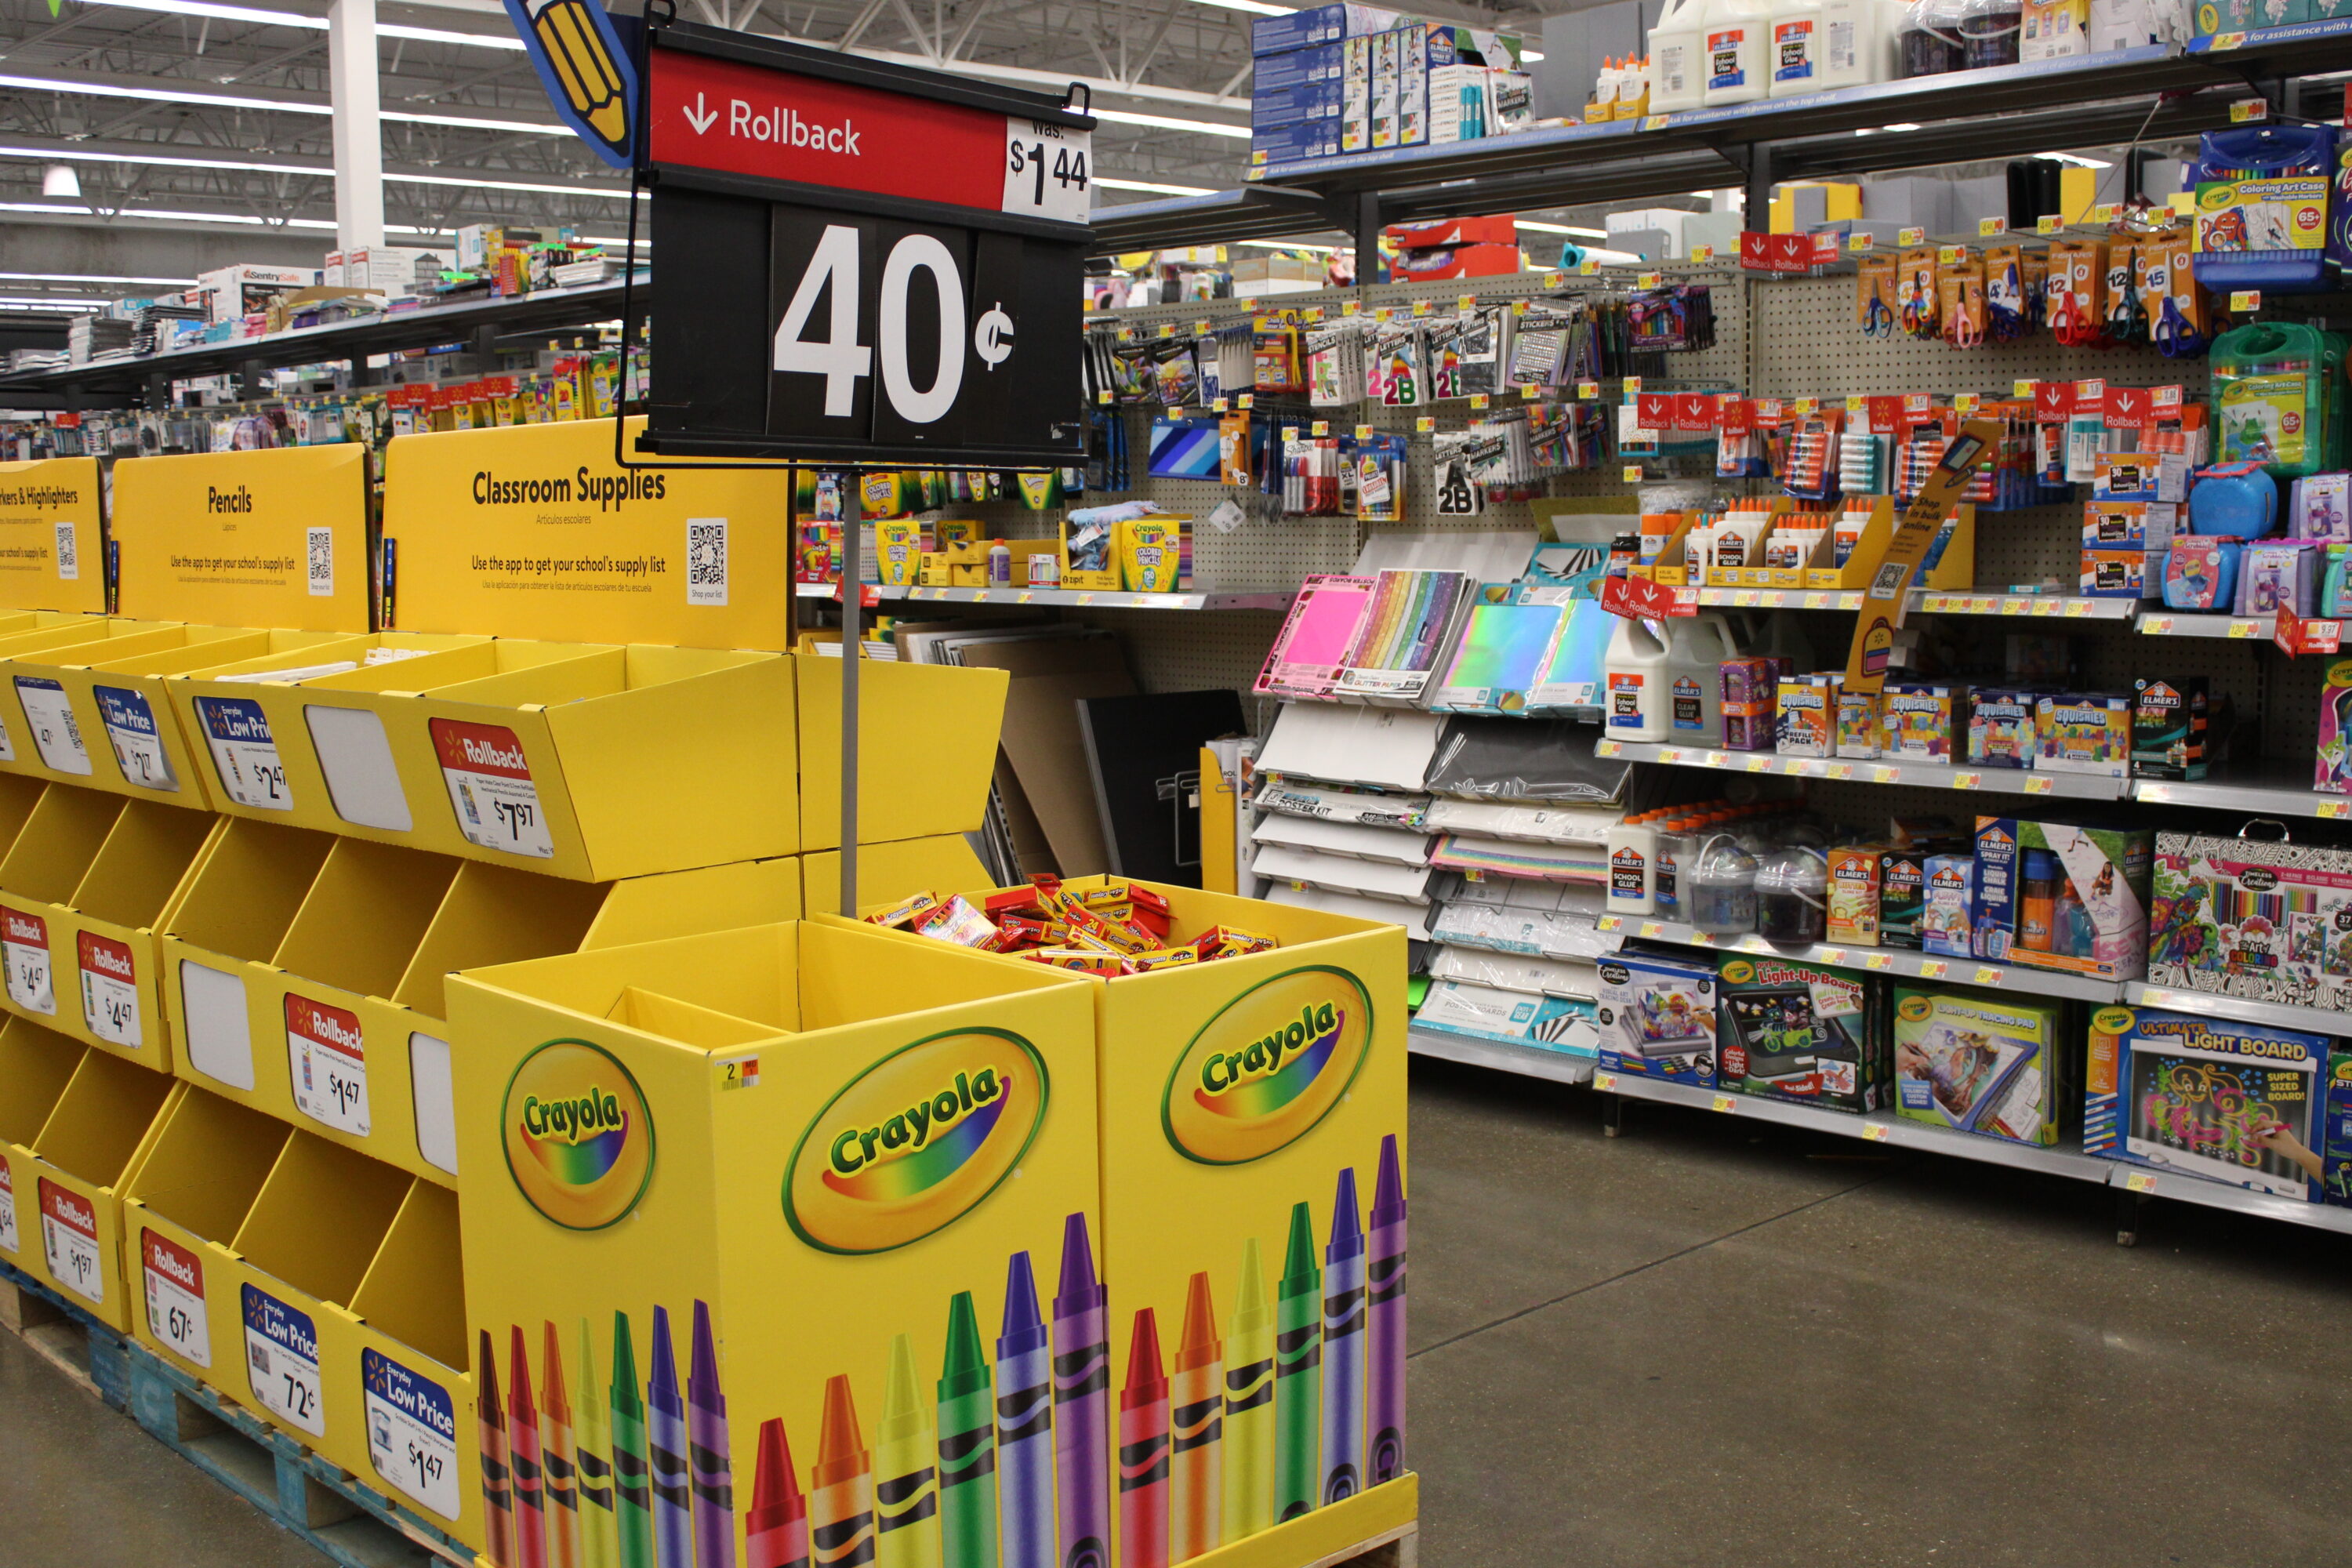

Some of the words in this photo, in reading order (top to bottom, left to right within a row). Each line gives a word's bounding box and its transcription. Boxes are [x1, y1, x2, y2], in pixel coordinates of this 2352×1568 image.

[2251, 33, 2265, 42] for
[2267, 27, 2321, 40] assistance
[2323, 21, 2348, 33] with
[1498, 94, 1526, 110] MARKERS
[1668, 115, 1681, 125] Ask
[1682, 114, 1693, 124] for
[1694, 107, 1736, 122] assistance
[1773, 102, 1785, 111] on
[1786, 99, 1798, 109] the
[1800, 96, 1814, 108] top
[730, 99, 860, 156] Rollback
[2239, 183, 2281, 196] Coloring
[2282, 183, 2299, 192] Art
[2299, 182, 2326, 191] Case
[2297, 212, 2321, 223] 65+
[2148, 238, 2189, 252] FISKARS
[2051, 251, 2093, 260] FISKARS
[1742, 256, 1772, 270] Rollback
[1774, 258, 1806, 271] Rollback
[250, 270, 299, 283] SentrySafe
[1519, 318, 1555, 329] STICKERS
[1308, 337, 1337, 354] STENCILS
[1380, 335, 1406, 350] LETTERS
[2038, 410, 2067, 421] Rollback
[2106, 415, 2143, 427] Rollback
[2282, 416, 2301, 426] 65+
[1639, 417, 1669, 430] Rollback
[1680, 418, 1708, 430] Rollback
[1286, 443, 1314, 456] Sharpie
[1470, 443, 1501, 459] MARKERS
[473, 472, 571, 505] Classroom
[577, 466, 666, 512] Supplies
[19, 487, 25, 505] &
[27, 485, 78, 510] Highlighters
[208, 485, 252, 514] Pencils
[1918, 496, 1940, 510] Shop
[1919, 510, 1942, 521] bulk
[886, 524, 907, 533] Crayola
[1135, 524, 1163, 533] Crayola
[1903, 521, 1933, 532] online
[1719, 538, 1744, 546] ELMER'S
[171, 555, 181, 568] Use
[183, 556, 192, 568] the
[193, 557, 203, 572] app
[205, 557, 211, 568] to
[212, 557, 222, 572] get
[223, 559, 236, 572] your
[238, 556, 262, 570] school's
[263, 558, 283, 573] supply
[285, 557, 295, 570] list
[472, 555, 487, 570] Use
[489, 556, 503, 571] the
[506, 559, 522, 575] app
[524, 557, 534, 571] to
[536, 557, 551, 575] get
[554, 560, 574, 575] your
[575, 556, 613, 572] school's
[615, 557, 648, 577] supply
[650, 556, 666, 573] list
[1069, 575, 1084, 585] zipit
[691, 590, 703, 600] Shop
[705, 591, 715, 600] your
[1628, 600, 1663, 619] Rollback
[2307, 641, 2336, 649] Rollback
[1674, 687, 1701, 696] ELMER'S
[1883, 685, 1901, 694] NEW
[1780, 695, 1824, 711] SQUISHIES
[1891, 697, 1940, 714] SQUISHIES
[2143, 695, 2178, 706] ELMER'S
[110, 706, 125, 726] Low
[126, 708, 151, 731] Price
[221, 706, 242, 717] Everyday
[2054, 709, 2107, 728] SQUISHIES
[224, 715, 249, 737] Low
[248, 716, 271, 739] Pri
[463, 738, 528, 771] Rollback
[1316, 805, 1334, 816] KIT
[1980, 840, 2013, 851] ELMER'S
[1613, 857, 1644, 866] ELMER'S
[1613, 872, 1642, 881] SCHOOL
[1837, 869, 1868, 880] ELMER'S
[1889, 872, 1922, 883] ELMER'S
[1618, 880, 1637, 889] GLUE
[1933, 879, 1963, 889] ELMER'S
[9, 916, 41, 942] Rollback
[1087, 918, 1099, 931] 24
[93, 946, 132, 977] Rollback
[1758, 967, 1819, 986] Light-Up
[1820, 974, 1862, 995] Board
[1937, 1003, 1976, 1020] LIGHT-UP
[1978, 1011, 2016, 1026] TRACING
[2017, 1017, 2036, 1029] PAD
[2099, 1012, 2130, 1022] Crayola
[313, 1011, 364, 1052] Rollback
[2139, 1022, 2208, 1036] ULTIMATE
[1202, 1000, 1336, 1094] Crayola
[2240, 1038, 2307, 1061] BOARD
[728, 1062, 735, 1080] 2
[2267, 1073, 2300, 1083] SUPER
[2270, 1082, 2299, 1092] SIZED
[2267, 1091, 2306, 1102] BOARD!
[524, 1086, 621, 1140] Crayola
[830, 1065, 1000, 1174] Crayola
[56, 1195, 95, 1232] Rollback
[154, 1244, 194, 1287] Rollback
[263, 1300, 285, 1321] Everyday
[264, 1310, 288, 1343] Low
[290, 1323, 318, 1361] Price
[387, 1362, 412, 1390] Everyday
[387, 1374, 416, 1407] Low
[419, 1394, 454, 1435] Price
